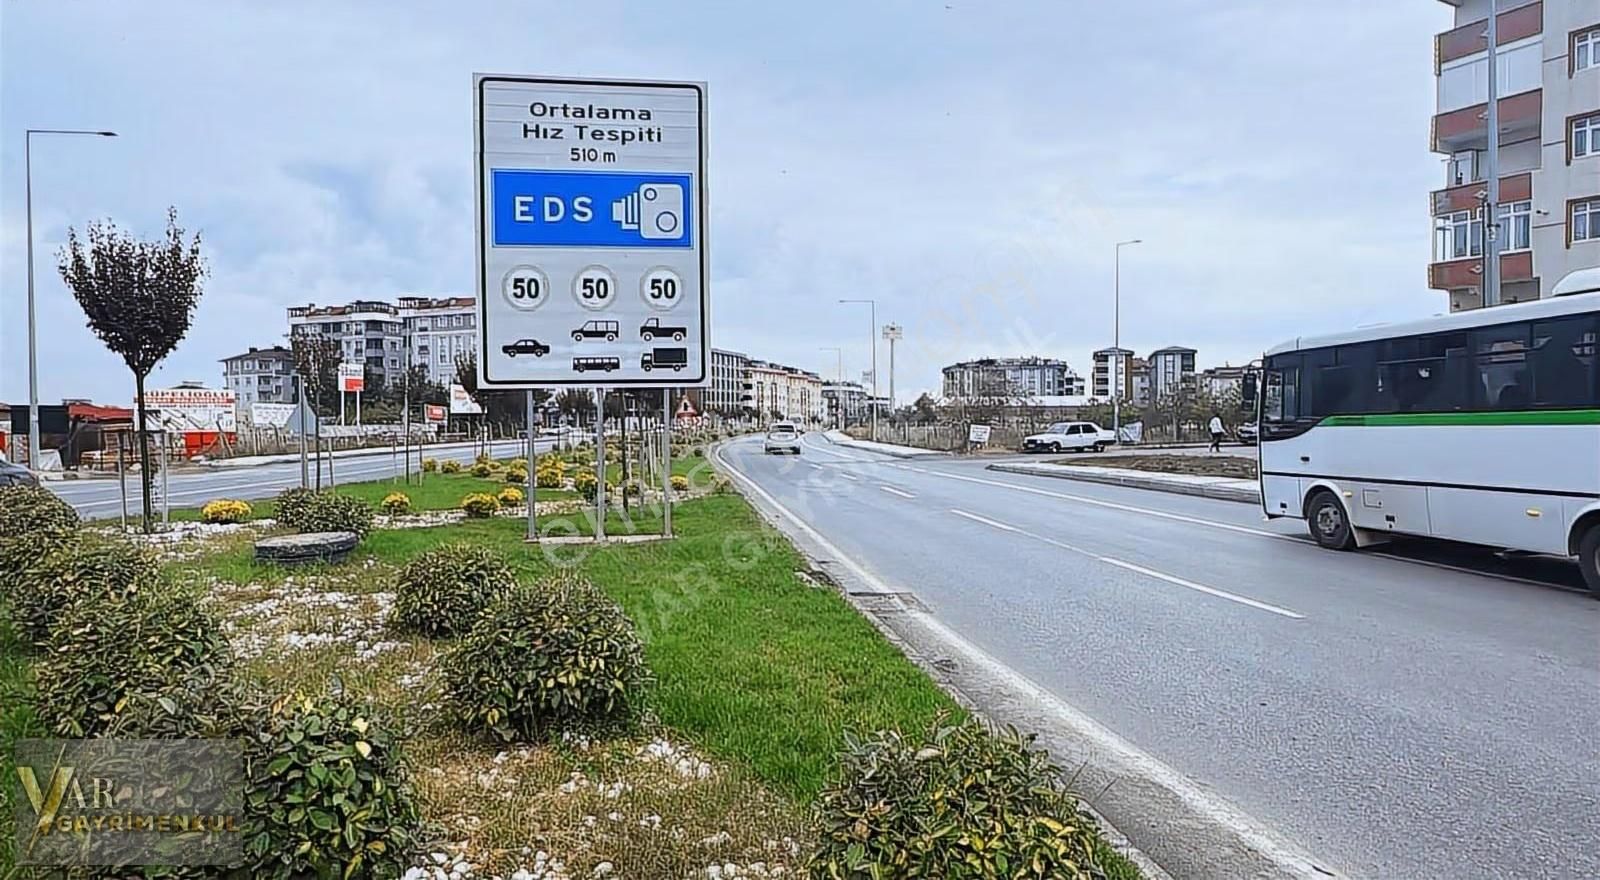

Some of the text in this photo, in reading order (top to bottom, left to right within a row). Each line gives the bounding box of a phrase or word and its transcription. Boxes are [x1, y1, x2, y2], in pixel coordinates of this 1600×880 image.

[530, 102, 651, 120] Ortalama
[523, 123, 662, 145] Hız Tespiti
[570, 148, 616, 163] 510 m
[514, 196, 593, 222] EDS
[513, 278, 540, 299] 50
[582, 278, 608, 299] 50
[650, 279, 676, 299] 50
